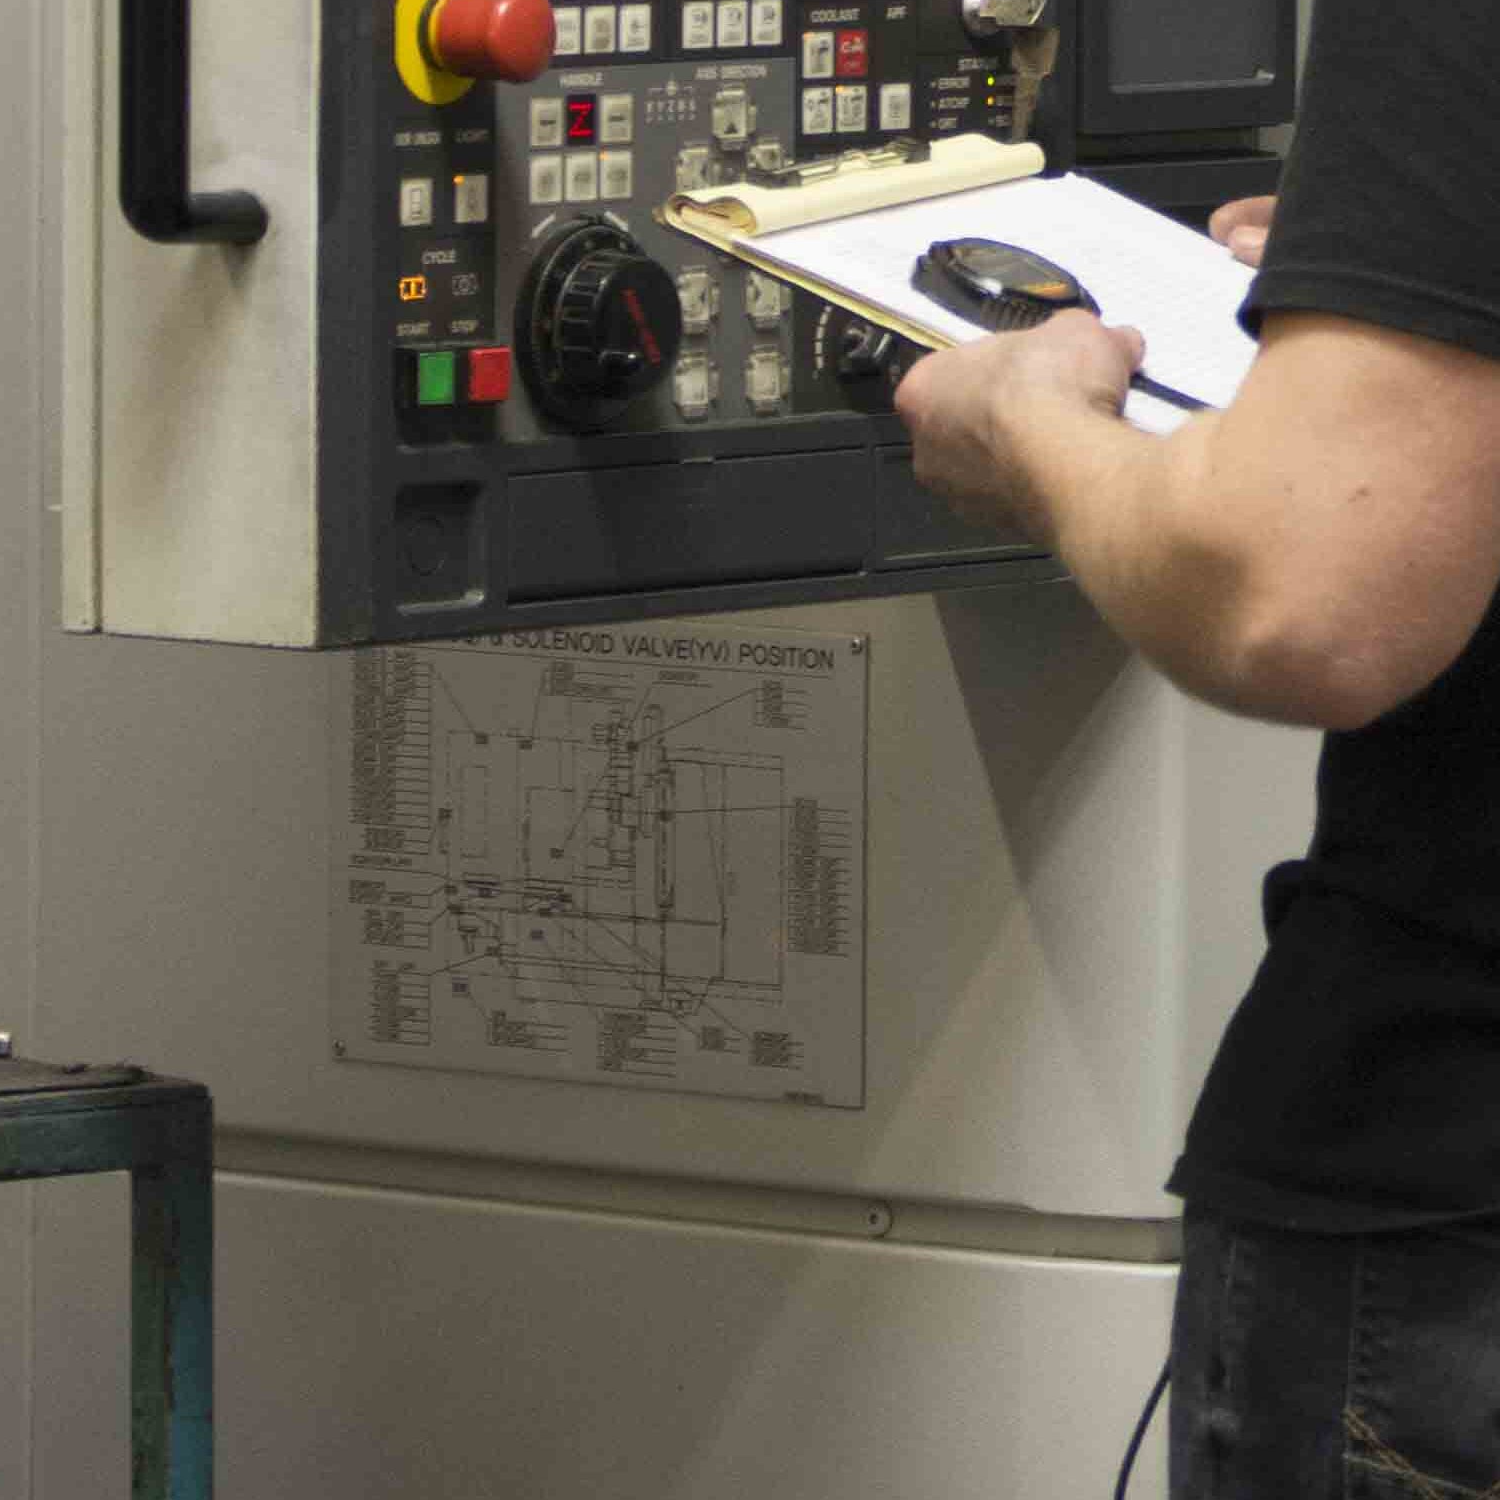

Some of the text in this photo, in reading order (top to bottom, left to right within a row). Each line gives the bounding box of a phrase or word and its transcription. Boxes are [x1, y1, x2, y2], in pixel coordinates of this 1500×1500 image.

[568, 102, 595, 137] Z
[513, 630, 615, 655] SOLENOID
[622, 638, 731, 664] VALVE(YV)
[737, 646, 835, 670] POSITION
